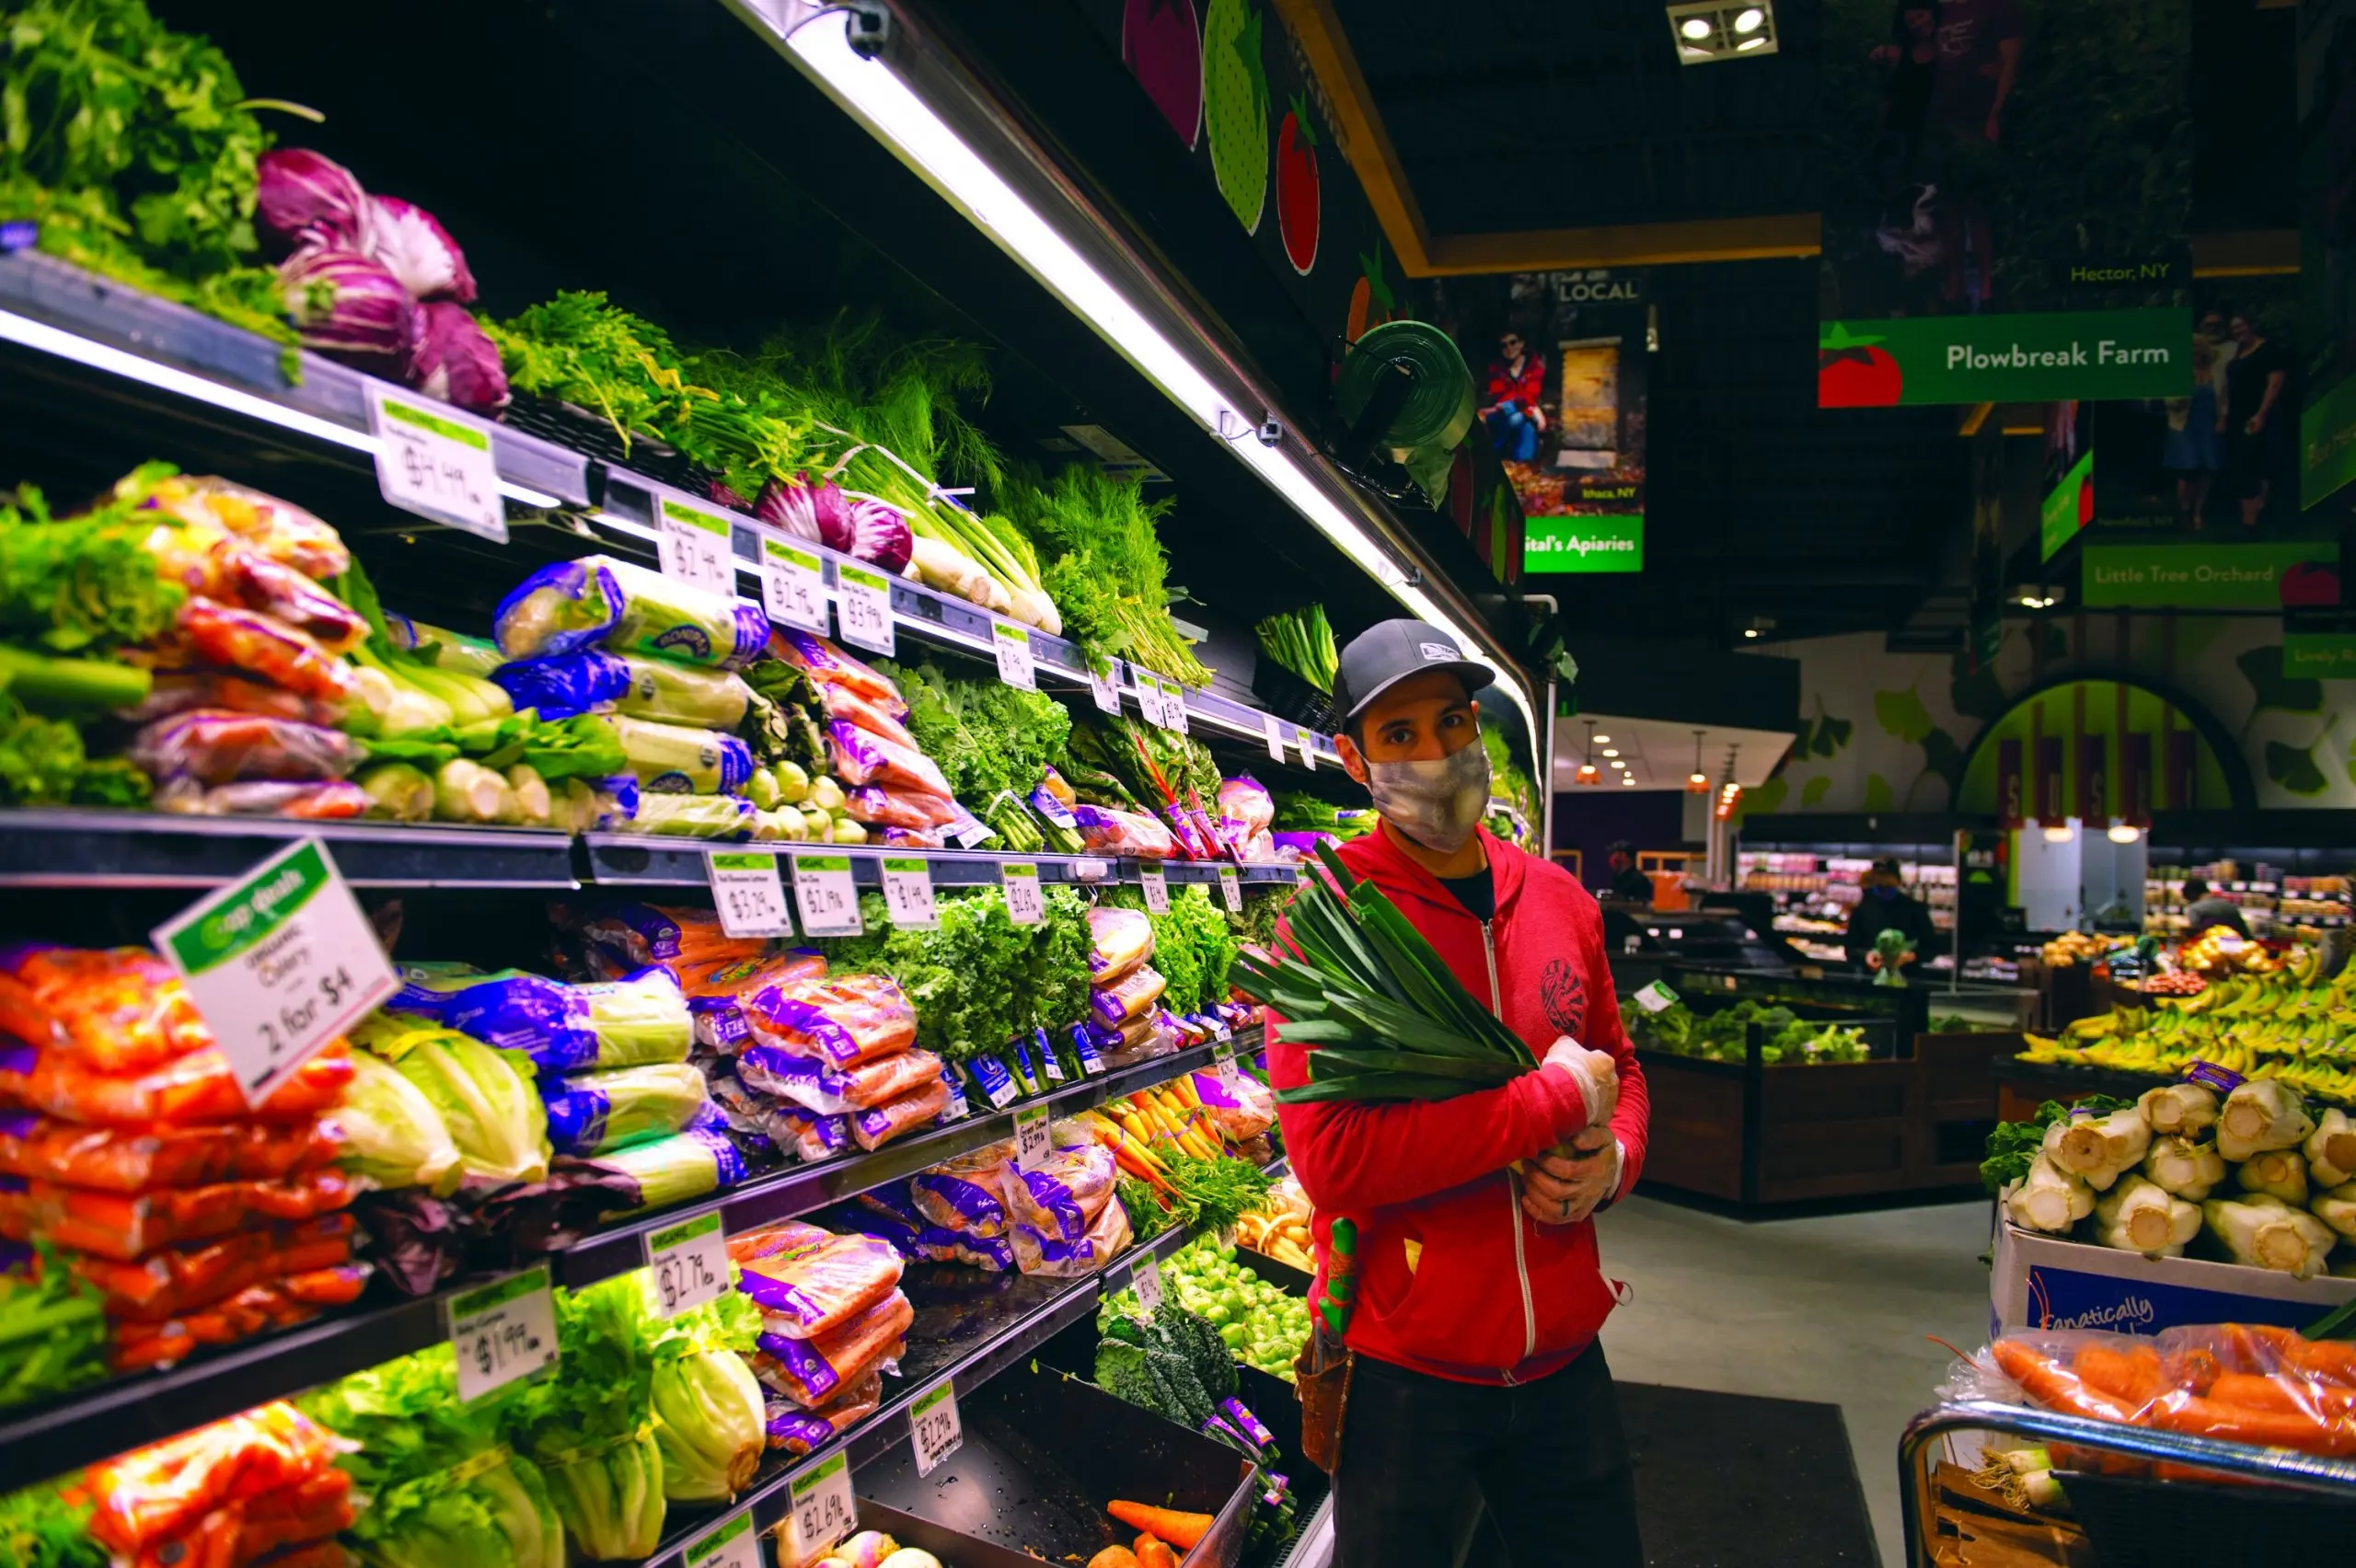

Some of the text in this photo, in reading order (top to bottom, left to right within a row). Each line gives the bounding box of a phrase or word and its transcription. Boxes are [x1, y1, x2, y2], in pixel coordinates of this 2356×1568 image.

[2140, 262, 2171, 279] NY
[1559, 280, 1638, 303] LOCAL
[1946, 340, 2170, 371] Plowbreak Farm
[1617, 487, 1636, 498] NY
[1524, 535, 1634, 558] ital's Apiaries
[2095, 564, 2274, 584] Little Tree Orchard
[257, 964, 356, 1055] 2 for $4
[2038, 1295, 2155, 1332] Fanatically
